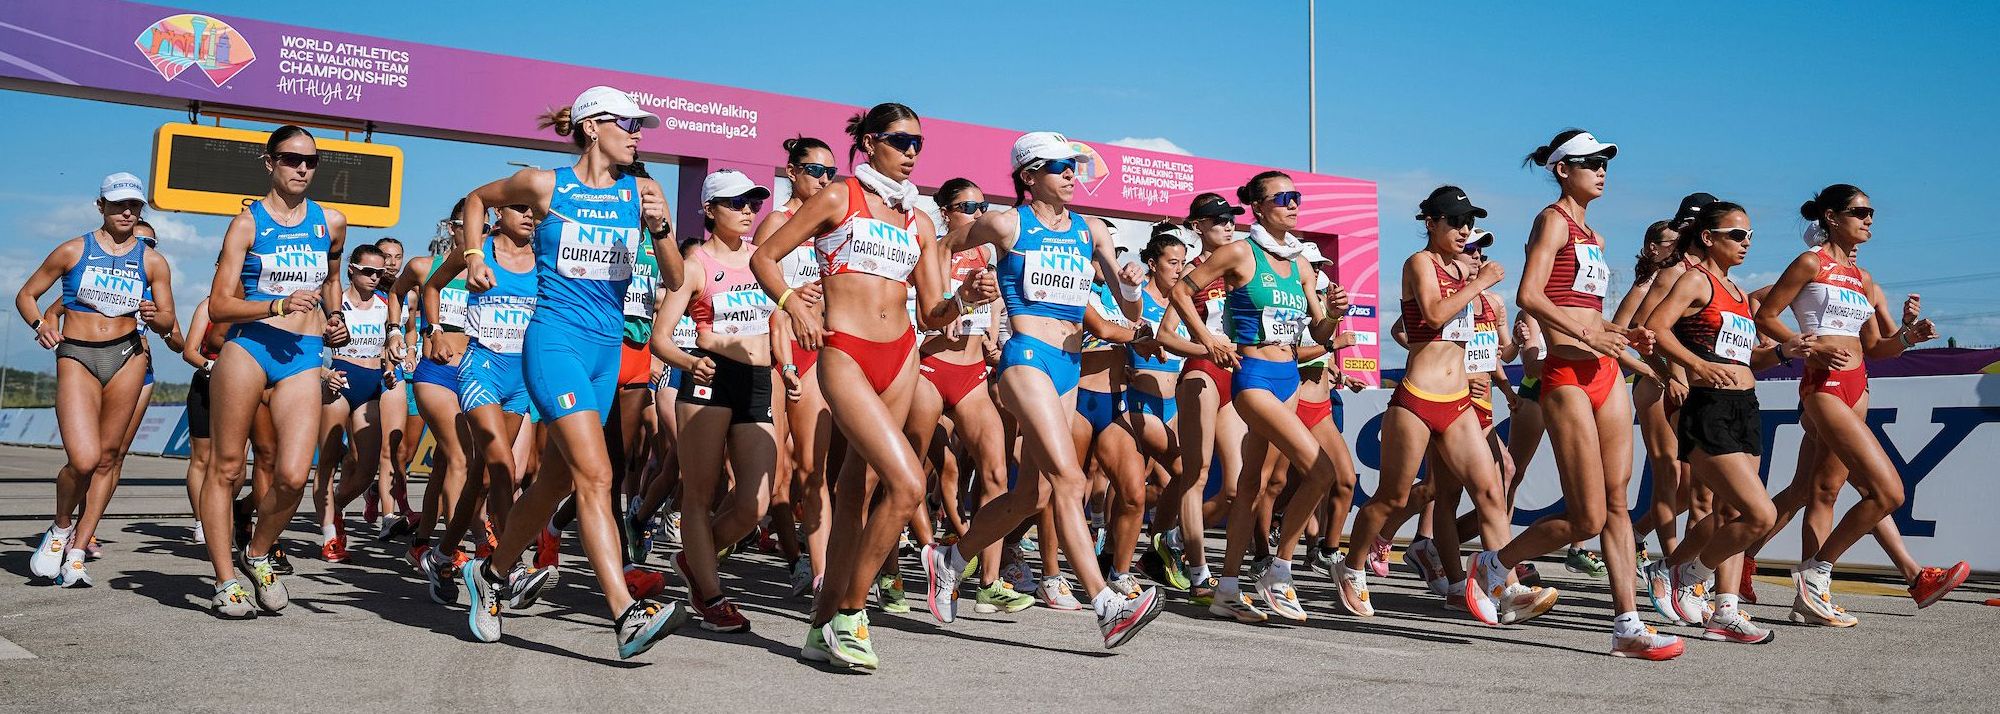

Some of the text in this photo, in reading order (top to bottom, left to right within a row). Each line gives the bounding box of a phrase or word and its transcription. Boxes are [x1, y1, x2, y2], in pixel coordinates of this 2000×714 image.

[282, 35, 410, 63] WORLD ATHLETICS
[280, 48, 409, 74] RACE WALKING TEAM
[279, 60, 408, 88] CHAMPIONSHIPS
[277, 75, 362, 105] ANTALYA 24
[628, 91, 758, 123] #WorldRaceWalking
[666, 117, 758, 139] @waantalya24
[1122, 155, 1193, 173] WORLD ATHLETICS
[1121, 165, 1194, 182] RACE WALKING TEAM
[1121, 174, 1194, 192] CHAMPIONSHIPS
[1120, 185, 1169, 207] ANTALYA 24
[577, 208, 618, 219] ITALIA
[578, 226, 629, 246] NTN
[869, 221, 909, 247] NTN
[276, 244, 312, 253] ITALIA
[562, 246, 621, 265] CURIAZZI
[853, 239, 885, 258] GARCÍA
[887, 246, 906, 264] LEÓN
[1041, 245, 1080, 256] ITALIA
[276, 253, 317, 267] NTN
[1041, 253, 1084, 273] NTN
[85, 266, 141, 280] ESTONIA
[269, 272, 307, 283] MIHAI
[632, 263, 652, 276] OPIA
[1586, 265, 1595, 279] Z.
[95, 275, 135, 294] NTN
[632, 276, 652, 290] TN
[730, 283, 762, 292] JAPA
[1031, 272, 1091, 291] GIORGI 609
[79, 287, 139, 308] MIROTVORTSEVA 557
[727, 291, 767, 307] NTN
[1839, 288, 1867, 306] NTN
[494, 308, 532, 325] NTN
[723, 309, 757, 321] YANAI
[352, 324, 381, 334] NTN
[672, 328, 697, 338] CARR
[1272, 323, 1296, 335] SENA
[1732, 314, 1756, 335] NTN
[350, 337, 378, 346] OUTARD
[1357, 333, 1369, 342] TN
[1468, 348, 1490, 361] PENG
[1344, 359, 1376, 370] SEIKO
